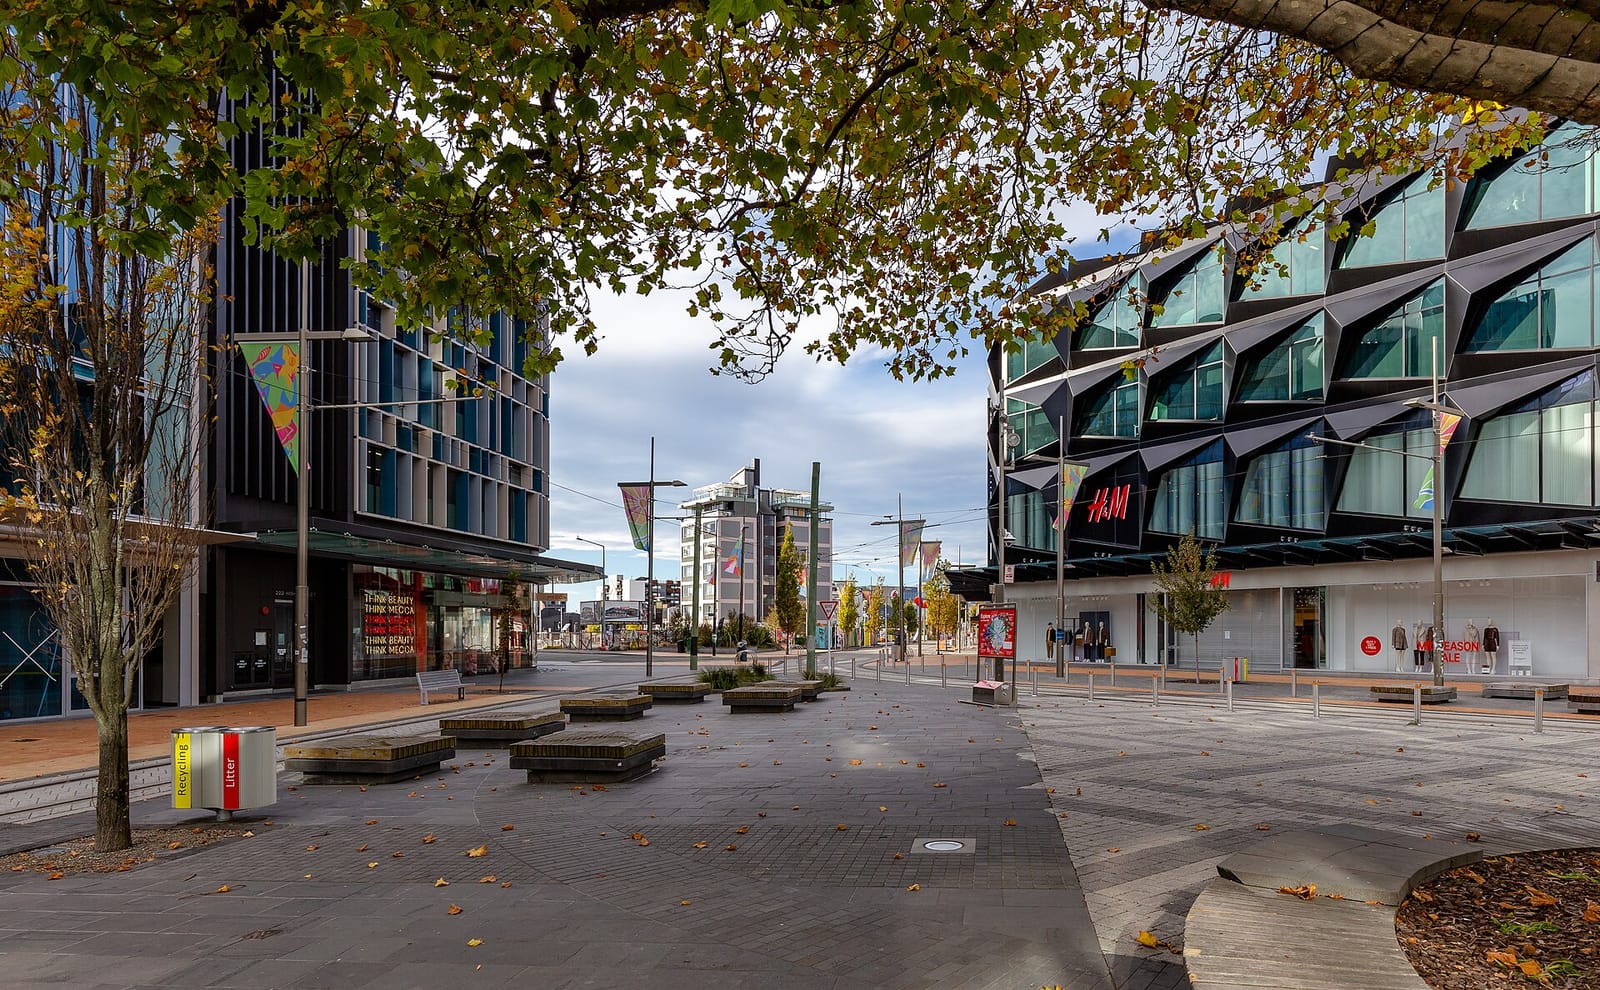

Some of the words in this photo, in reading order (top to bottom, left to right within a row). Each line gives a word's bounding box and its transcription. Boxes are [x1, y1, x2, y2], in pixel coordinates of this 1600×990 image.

[1088, 483, 1130, 523] H&M
[364, 594, 387, 603] THINK
[388, 596, 414, 604] BEAUTY
[365, 604, 387, 614] THINK
[388, 605, 415, 615] MECCA
[365, 635, 387, 645] THINK
[389, 635, 415, 645] BEAUTY
[365, 645, 387, 655] THINK
[388, 645, 415, 655] MECCA
[1443, 641, 1479, 651] EASON
[1443, 652, 1460, 663] ALE
[178, 744, 189, 796] Recycling
[226, 757, 235, 788] Litter
